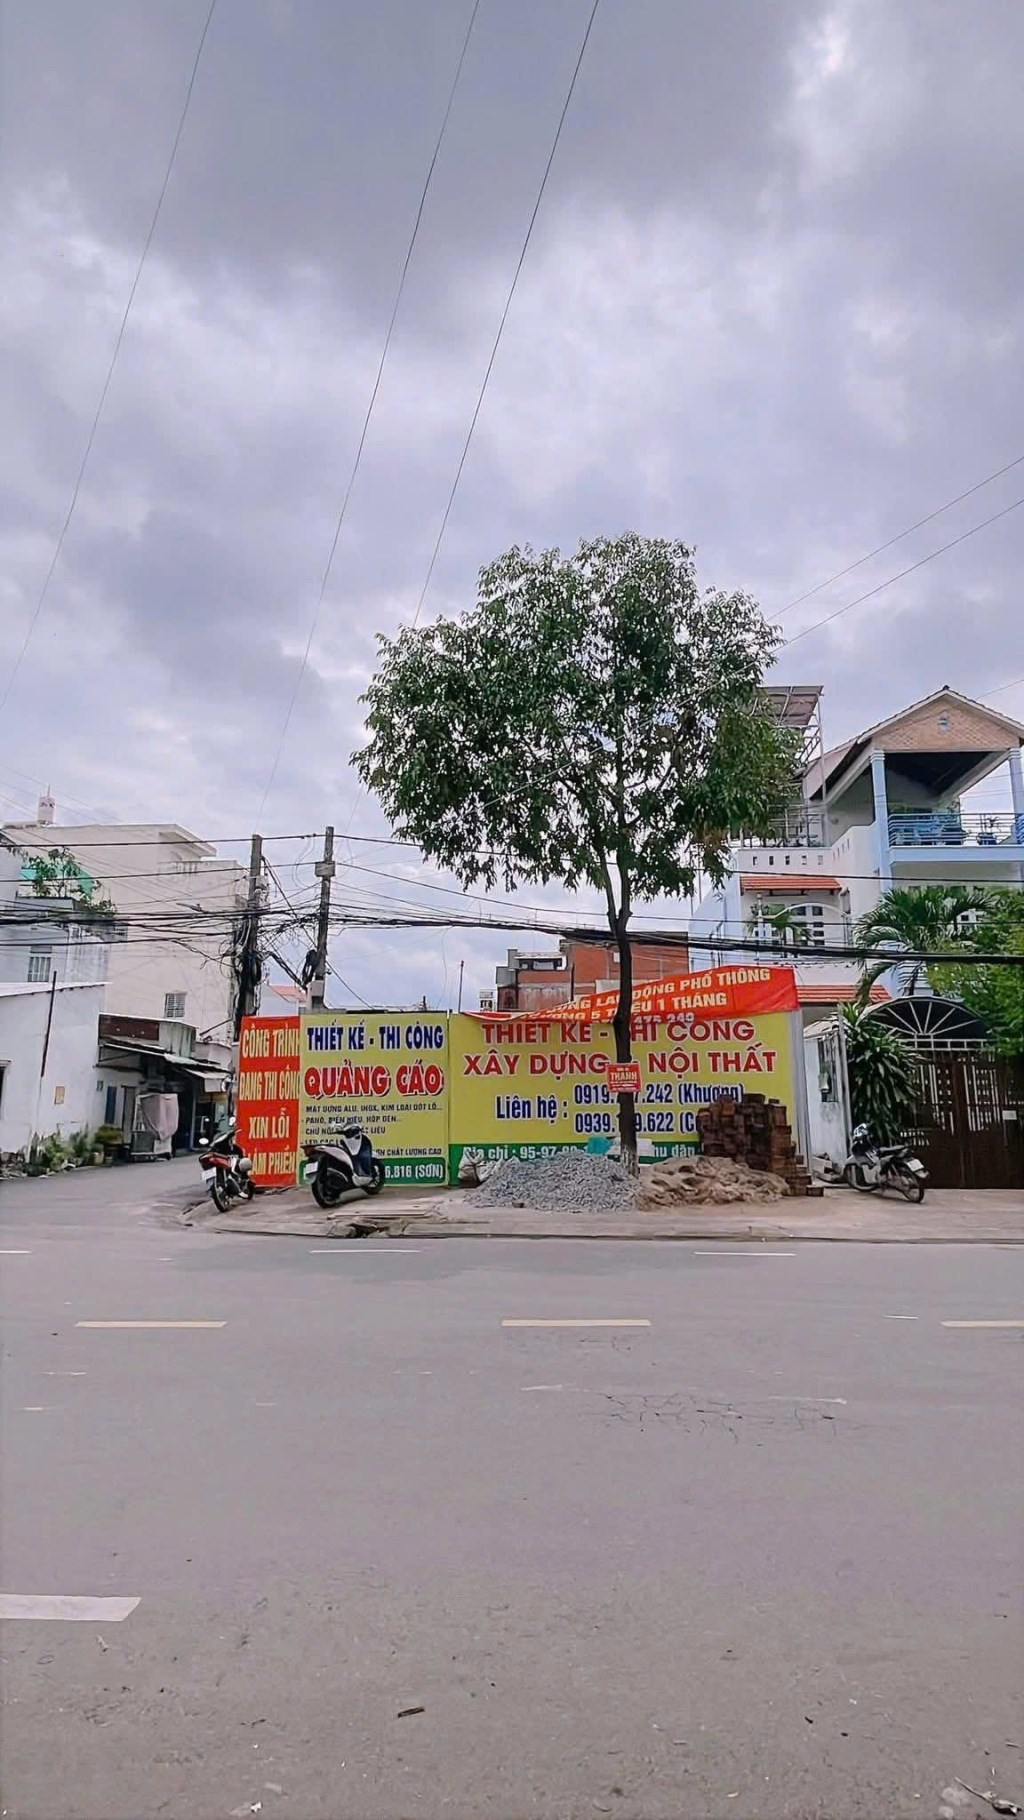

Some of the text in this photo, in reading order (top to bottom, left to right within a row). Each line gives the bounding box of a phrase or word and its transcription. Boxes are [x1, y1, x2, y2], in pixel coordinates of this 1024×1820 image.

[717, 968, 771, 986] THÔNG
[592, 1010, 601, 1020] 5
[657, 1001, 665, 1011] 1
[672, 992, 727, 1010] THÁNG
[242, 1023, 270, 1058] CÔNG
[307, 1019, 344, 1051] THIẾT
[348, 1019, 365, 1050] KẾ
[379, 1025, 400, 1049] THI
[405, 1021, 444, 1049] CÔNG
[463, 1042, 776, 1080] XÂY DỰNG NỘI THẤT
[264, 1071, 278, 1100] THI
[304, 1059, 391, 1100] QUẢNG
[248, 1107, 290, 1139] XIN LỖI
[496, 1095, 531, 1119] Liên
[537, 1095, 558, 1123] hệ
[575, 1112, 674, 1132] 0939.9.622
[385, 1163, 444, 1179] 6.816 (SƠN)
